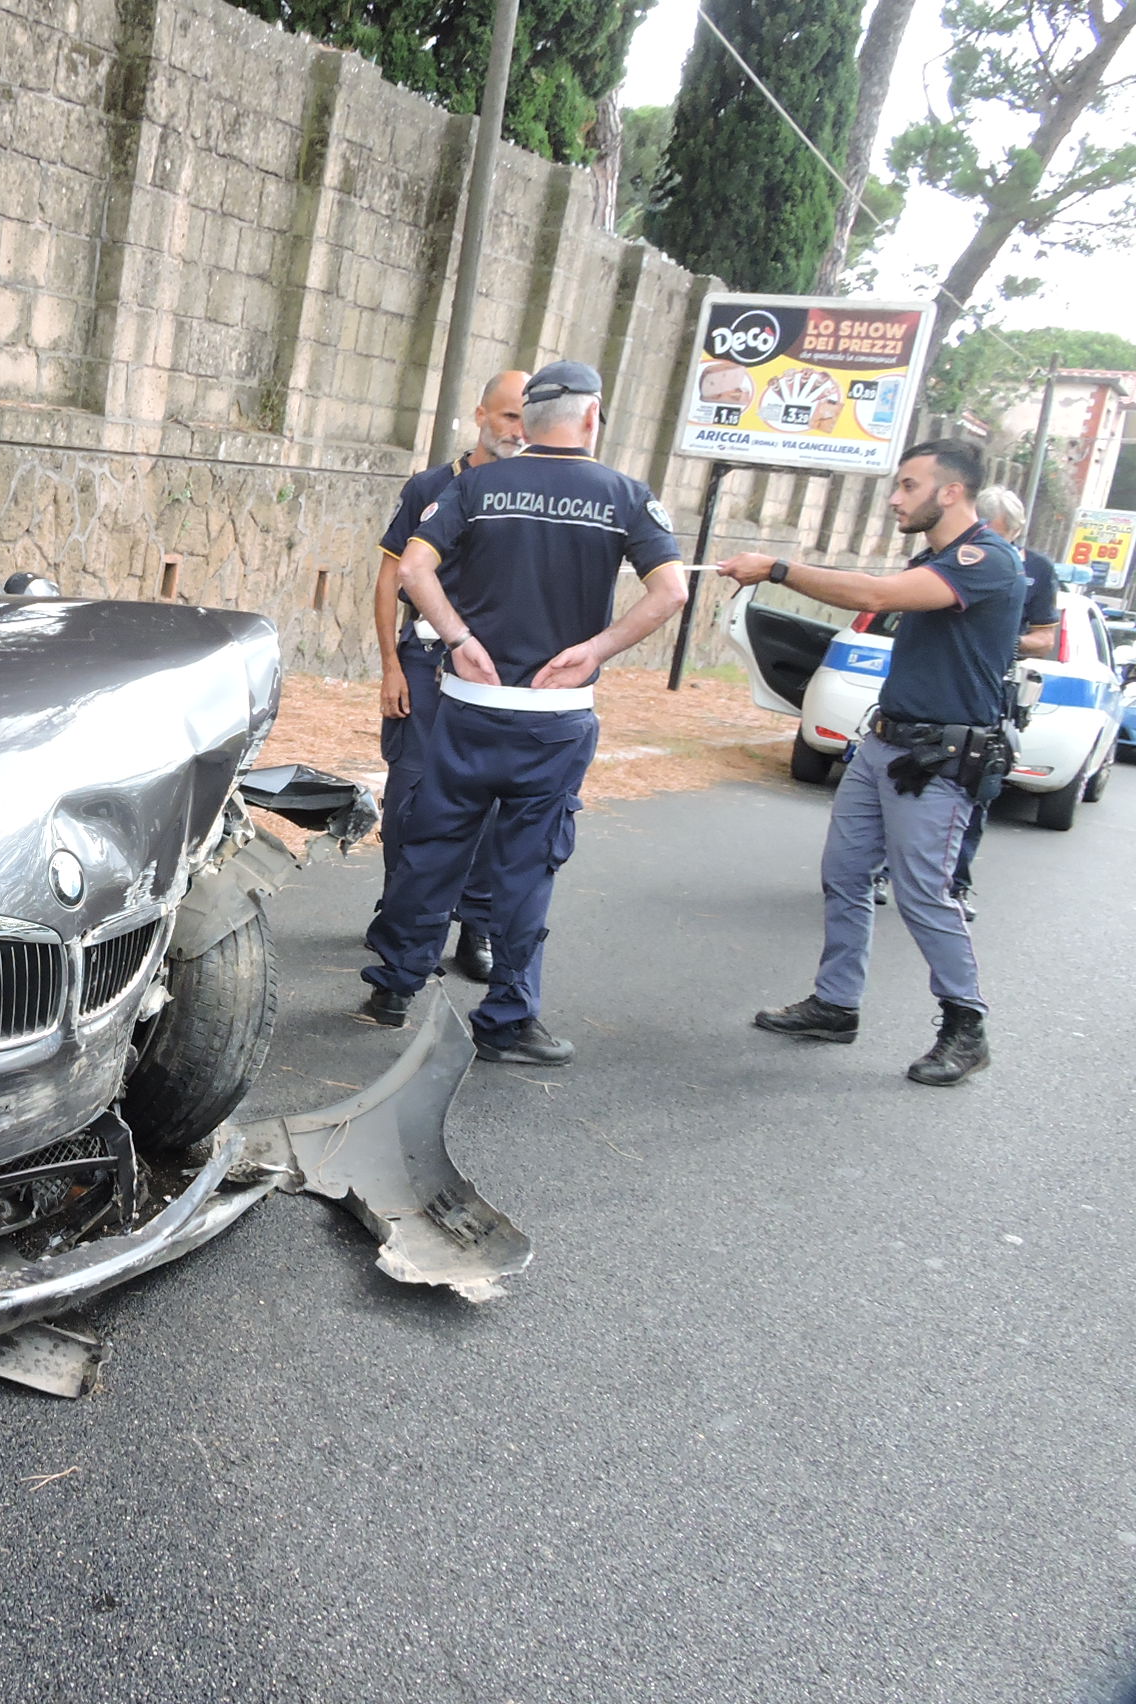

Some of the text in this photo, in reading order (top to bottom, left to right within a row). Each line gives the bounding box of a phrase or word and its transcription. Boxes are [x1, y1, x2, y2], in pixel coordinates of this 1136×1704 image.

[807, 319, 908, 339] LO SHOW
[803, 335, 904, 354] DEI PREZZI
[696, 429, 751, 444] ARICCIA
[751, 439, 779, 448] (ROMA)
[782, 440, 797, 449] VIA
[864, 448, 877, 457] 36
[482, 491, 616, 523] POLIZIA LOCALE
[1071, 542, 1093, 565] 8
